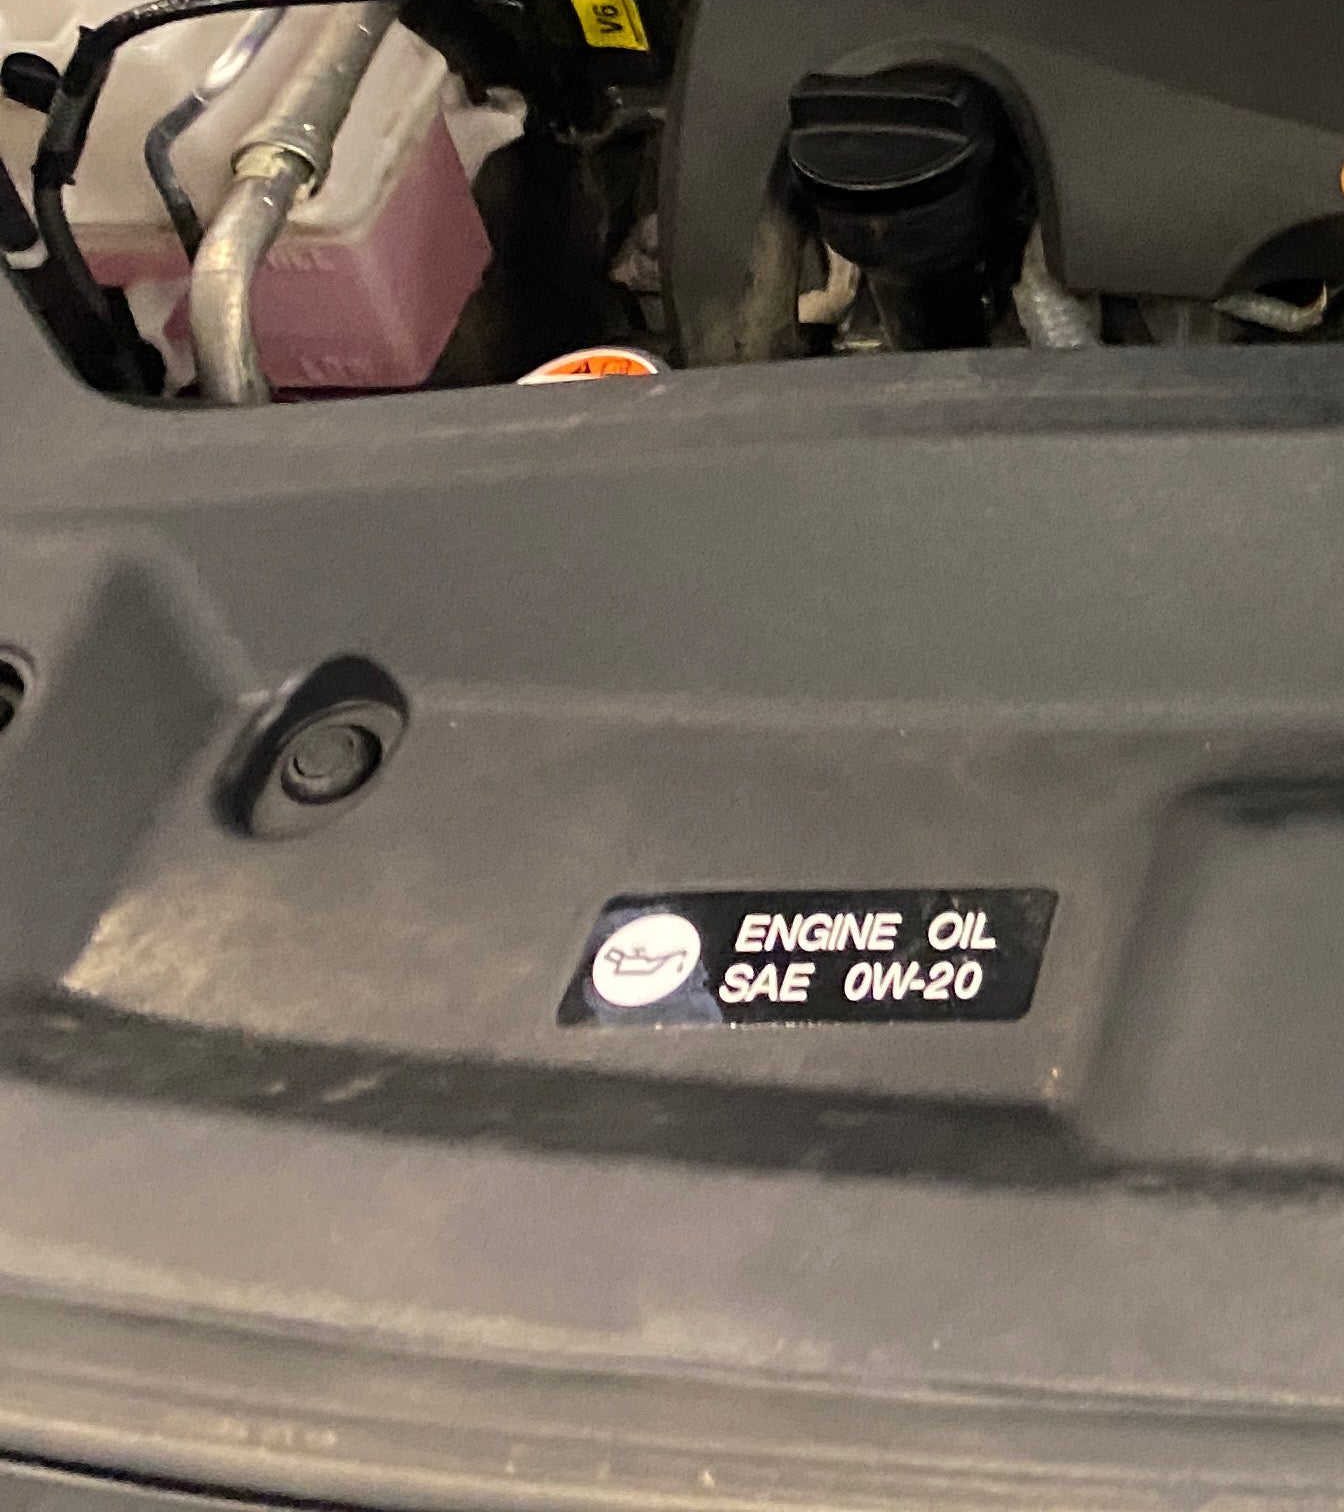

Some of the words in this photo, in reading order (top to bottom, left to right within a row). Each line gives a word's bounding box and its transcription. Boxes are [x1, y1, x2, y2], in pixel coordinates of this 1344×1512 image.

[592, 4, 624, 34] V6
[734, 911, 903, 953] ENGINE
[926, 910, 998, 951] OIL
[718, 962, 816, 1004] SAE
[843, 961, 984, 1002] 0W-20
